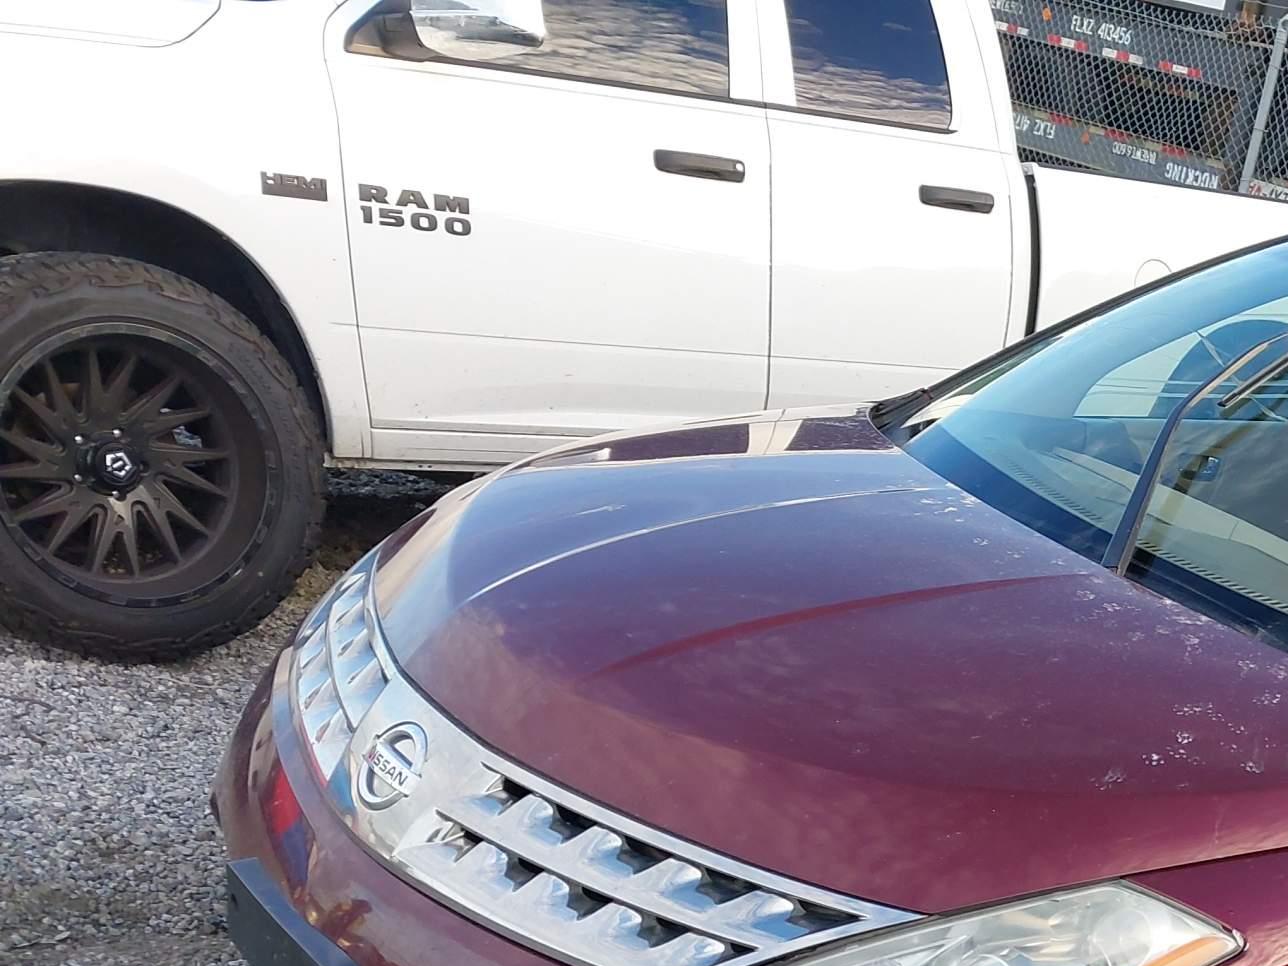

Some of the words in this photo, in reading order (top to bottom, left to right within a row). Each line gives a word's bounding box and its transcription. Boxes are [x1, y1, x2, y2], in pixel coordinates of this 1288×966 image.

[1071, 15, 1094, 35] FLXZ
[1097, 24, 1132, 45] 413456
[260, 171, 328, 201] HEMI
[358, 183, 470, 215] RAM
[360, 205, 472, 236] 1500
[367, 744, 408, 786] NISSAN
